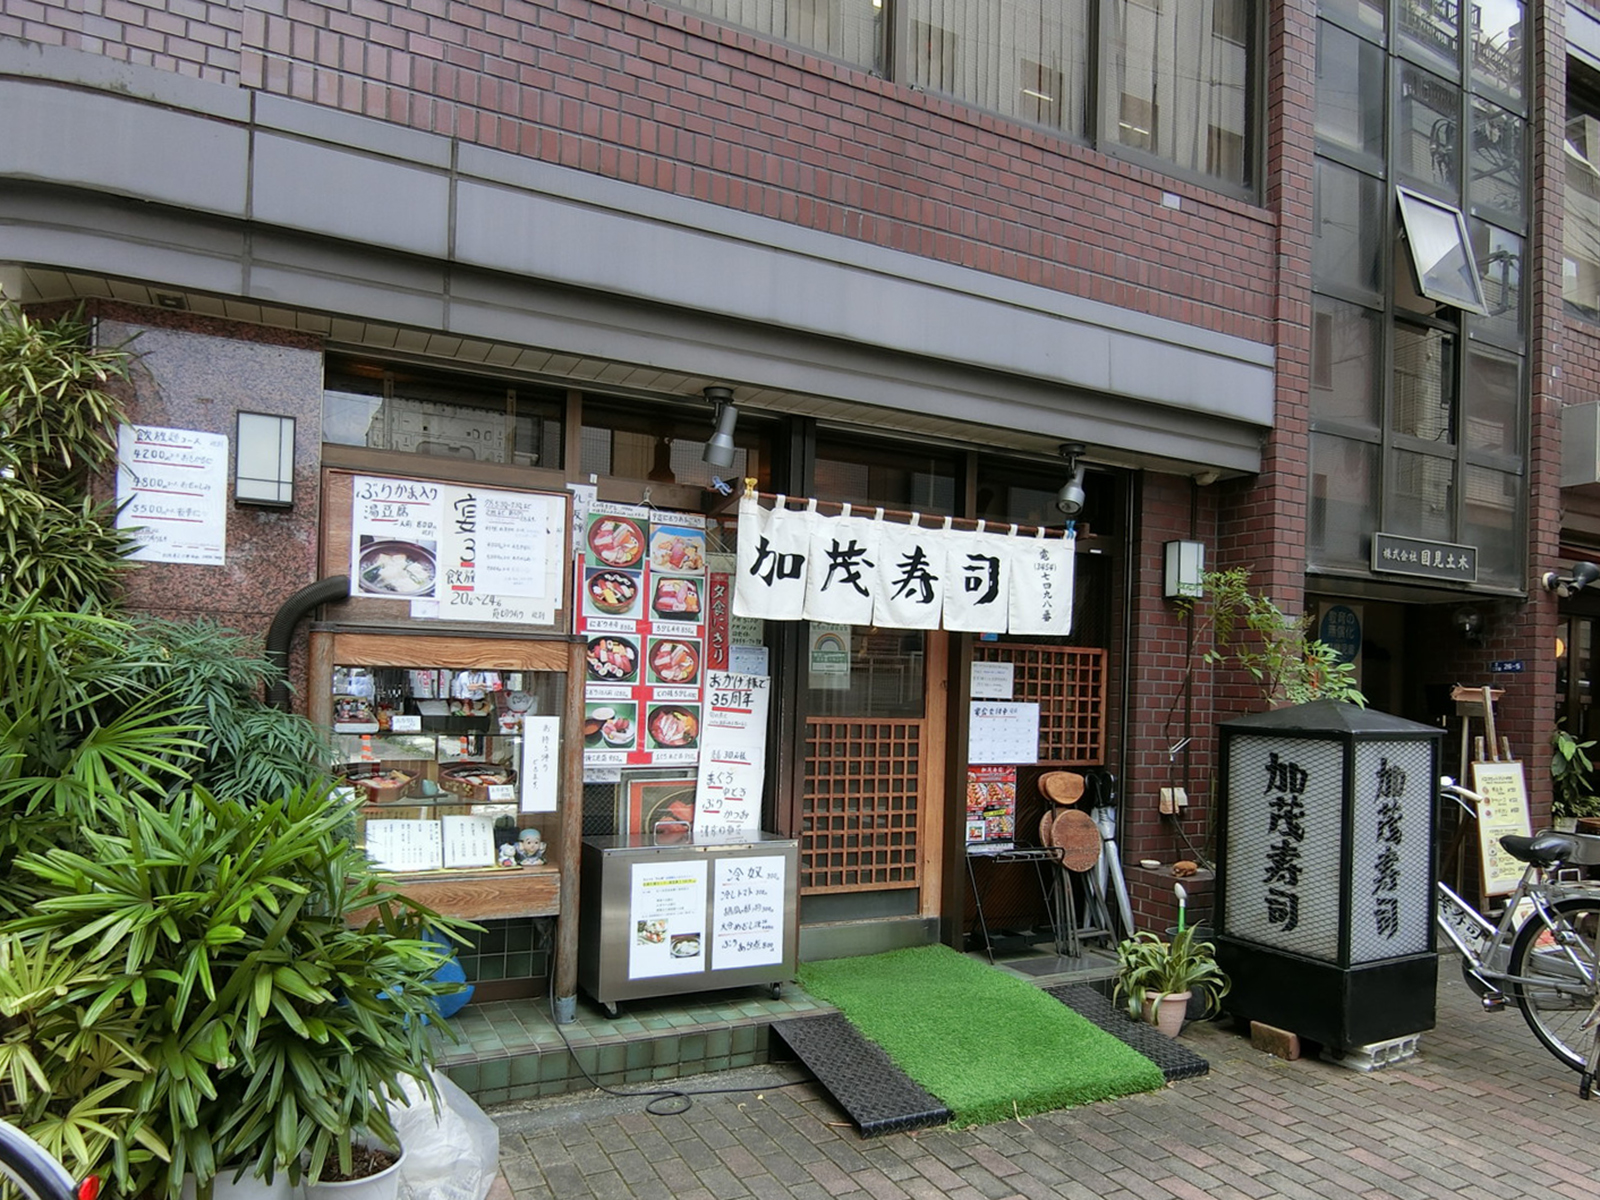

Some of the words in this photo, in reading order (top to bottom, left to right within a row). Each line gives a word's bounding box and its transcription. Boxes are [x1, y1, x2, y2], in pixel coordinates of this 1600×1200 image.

[356, 482, 438, 501] ぶりかま入り
[363, 504, 410, 520] 湯豆腐
[1383, 547, 1418, 562] 株式会社
[749, 534, 1002, 606] 加茂寿司
[709, 673, 770, 690] おかげ様で
[710, 691, 755, 708] 35周年
[706, 770, 733, 786] まぐろ
[702, 798, 723, 810] ぶり
[1263, 752, 1309, 933] 加茂寿司
[1373, 757, 1407, 941] 加茂寿司
[727, 866, 763, 882] 冷奴
[720, 886, 754, 901] 冷しトマト
